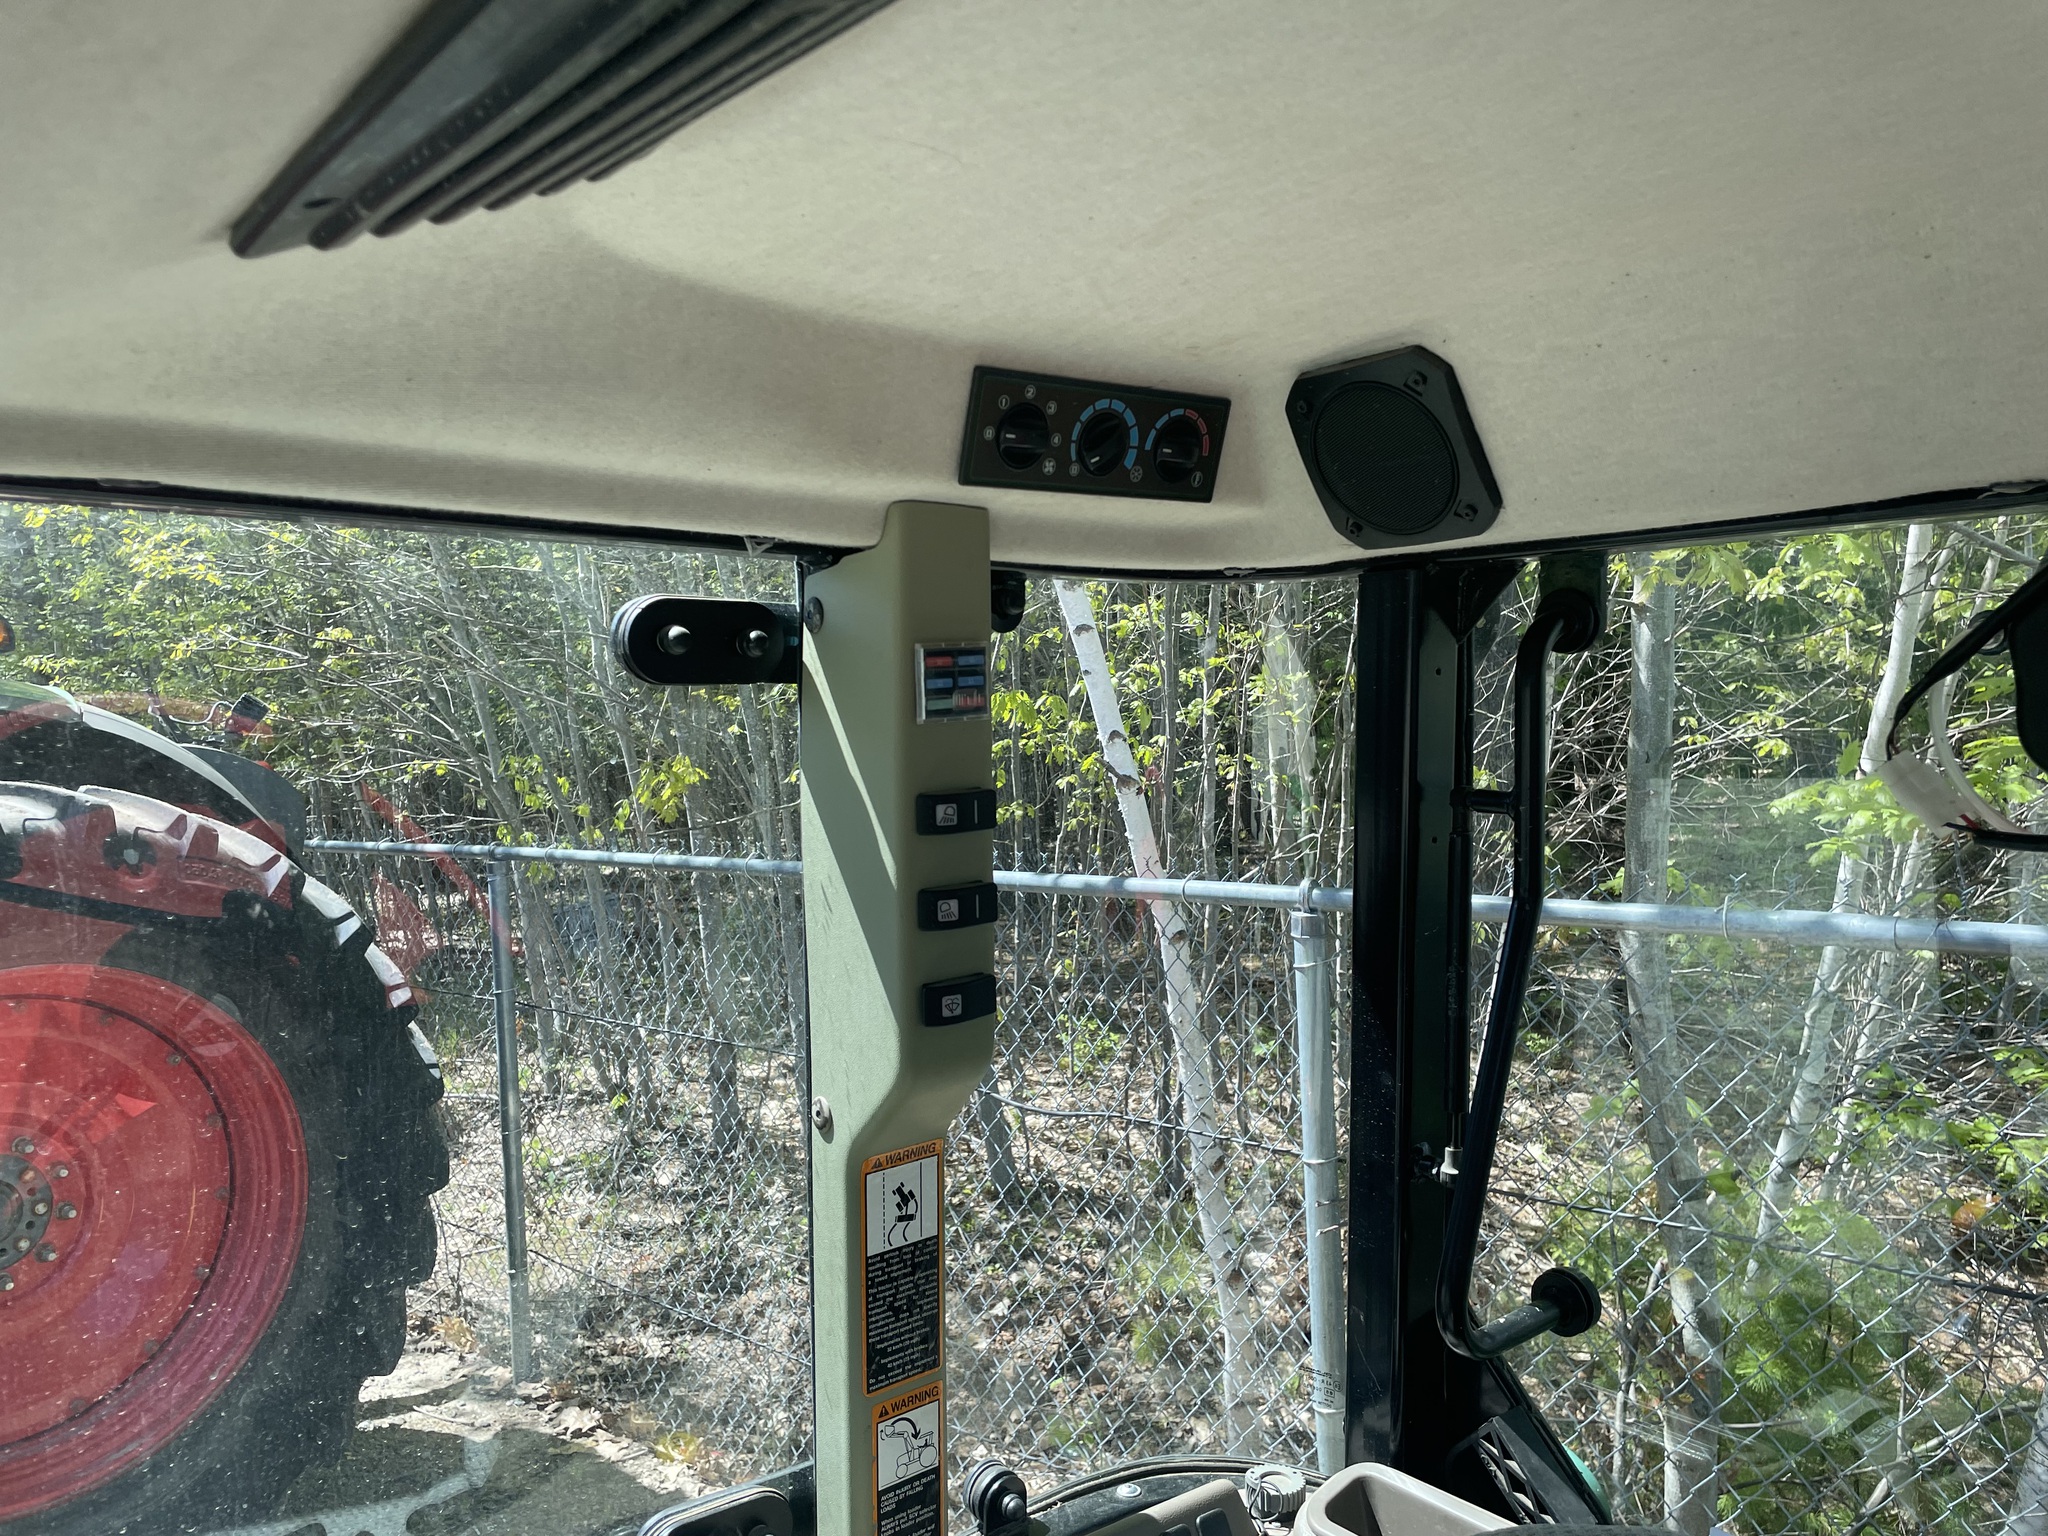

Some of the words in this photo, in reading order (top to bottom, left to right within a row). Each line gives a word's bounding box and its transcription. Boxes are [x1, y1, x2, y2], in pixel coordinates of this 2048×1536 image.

[885, 1142, 937, 1167] WARNING
[885, 1263, 903, 1272] transport
[870, 1381, 889, 1390] maximum
[890, 1373, 908, 1383] transport
[888, 1368, 902, 1377] exceed
[890, 1385, 939, 1413] WARNING
[881, 1492, 895, 1501] AVOID
[896, 1483, 911, 1495] INJURY
[921, 1474, 936, 1484] DEATH
[881, 1496, 899, 1508] CAUSED
[906, 1485, 924, 1496] FALLING
[881, 1503, 896, 1514] LOADS
[881, 1517, 894, 1526] When
[895, 1512, 907, 1520] using
[908, 1505, 922, 1514] loader
[881, 1520, 899, 1531] ALWAYS
[909, 1511, 918, 1519] SCV
[919, 1504, 937, 1515] selector
[901, 1520, 915, 1529] loader
